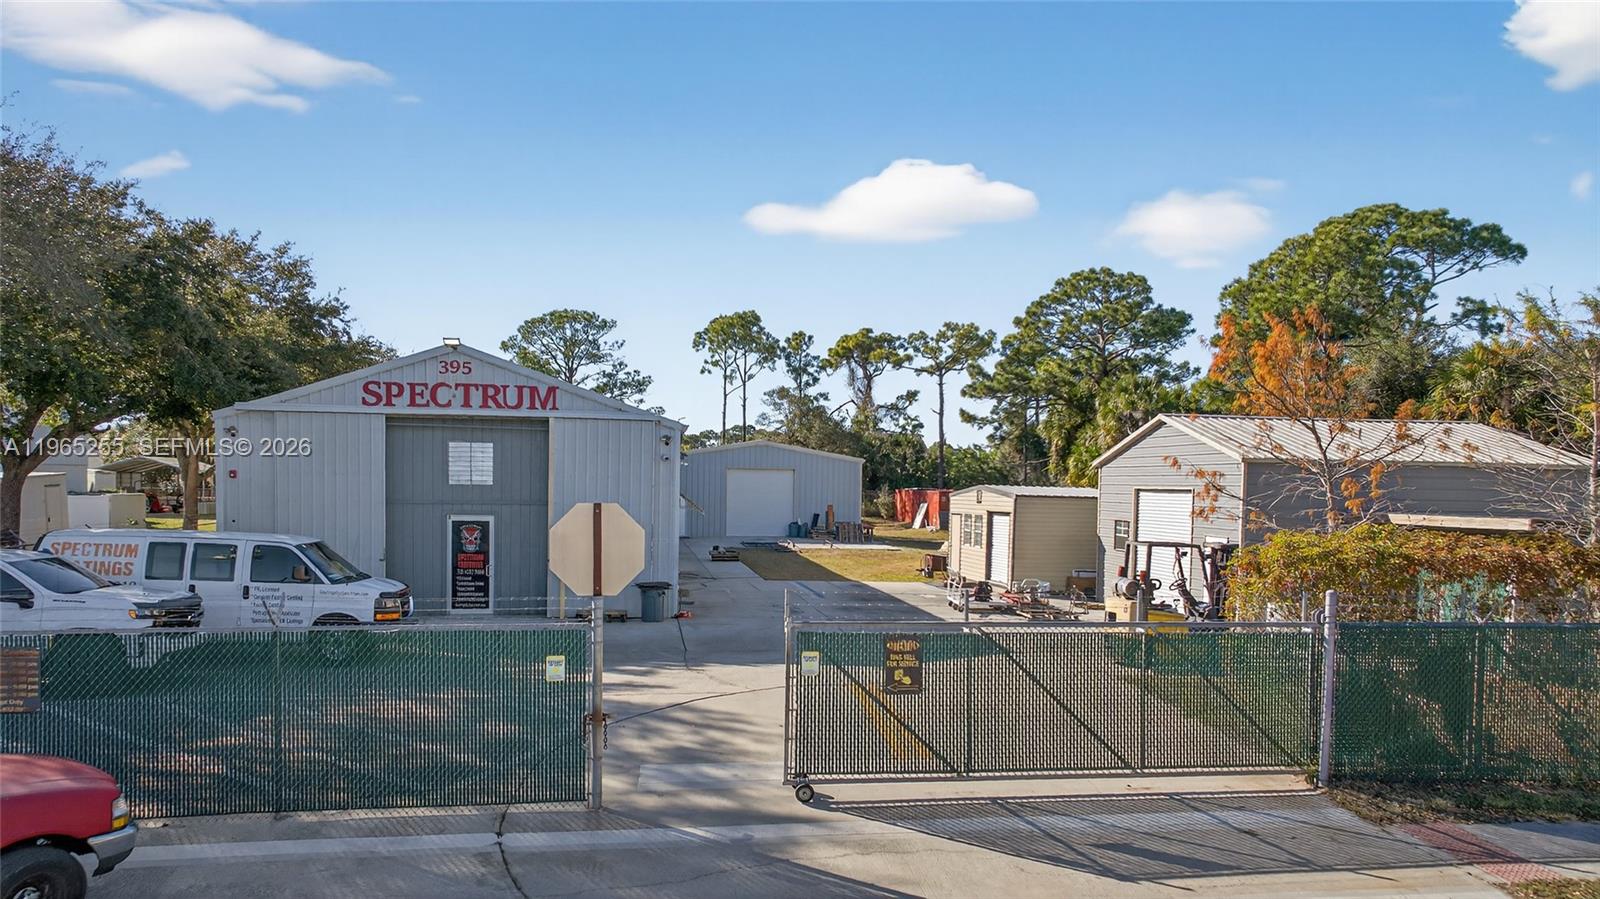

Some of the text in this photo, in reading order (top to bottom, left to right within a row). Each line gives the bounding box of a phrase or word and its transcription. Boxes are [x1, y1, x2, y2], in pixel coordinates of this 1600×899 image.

[438, 360, 472, 375] 395
[361, 380, 560, 411] SPECTRUM
[51, 541, 139, 558] SPECTRUM
[75, 560, 134, 577] TINGS
